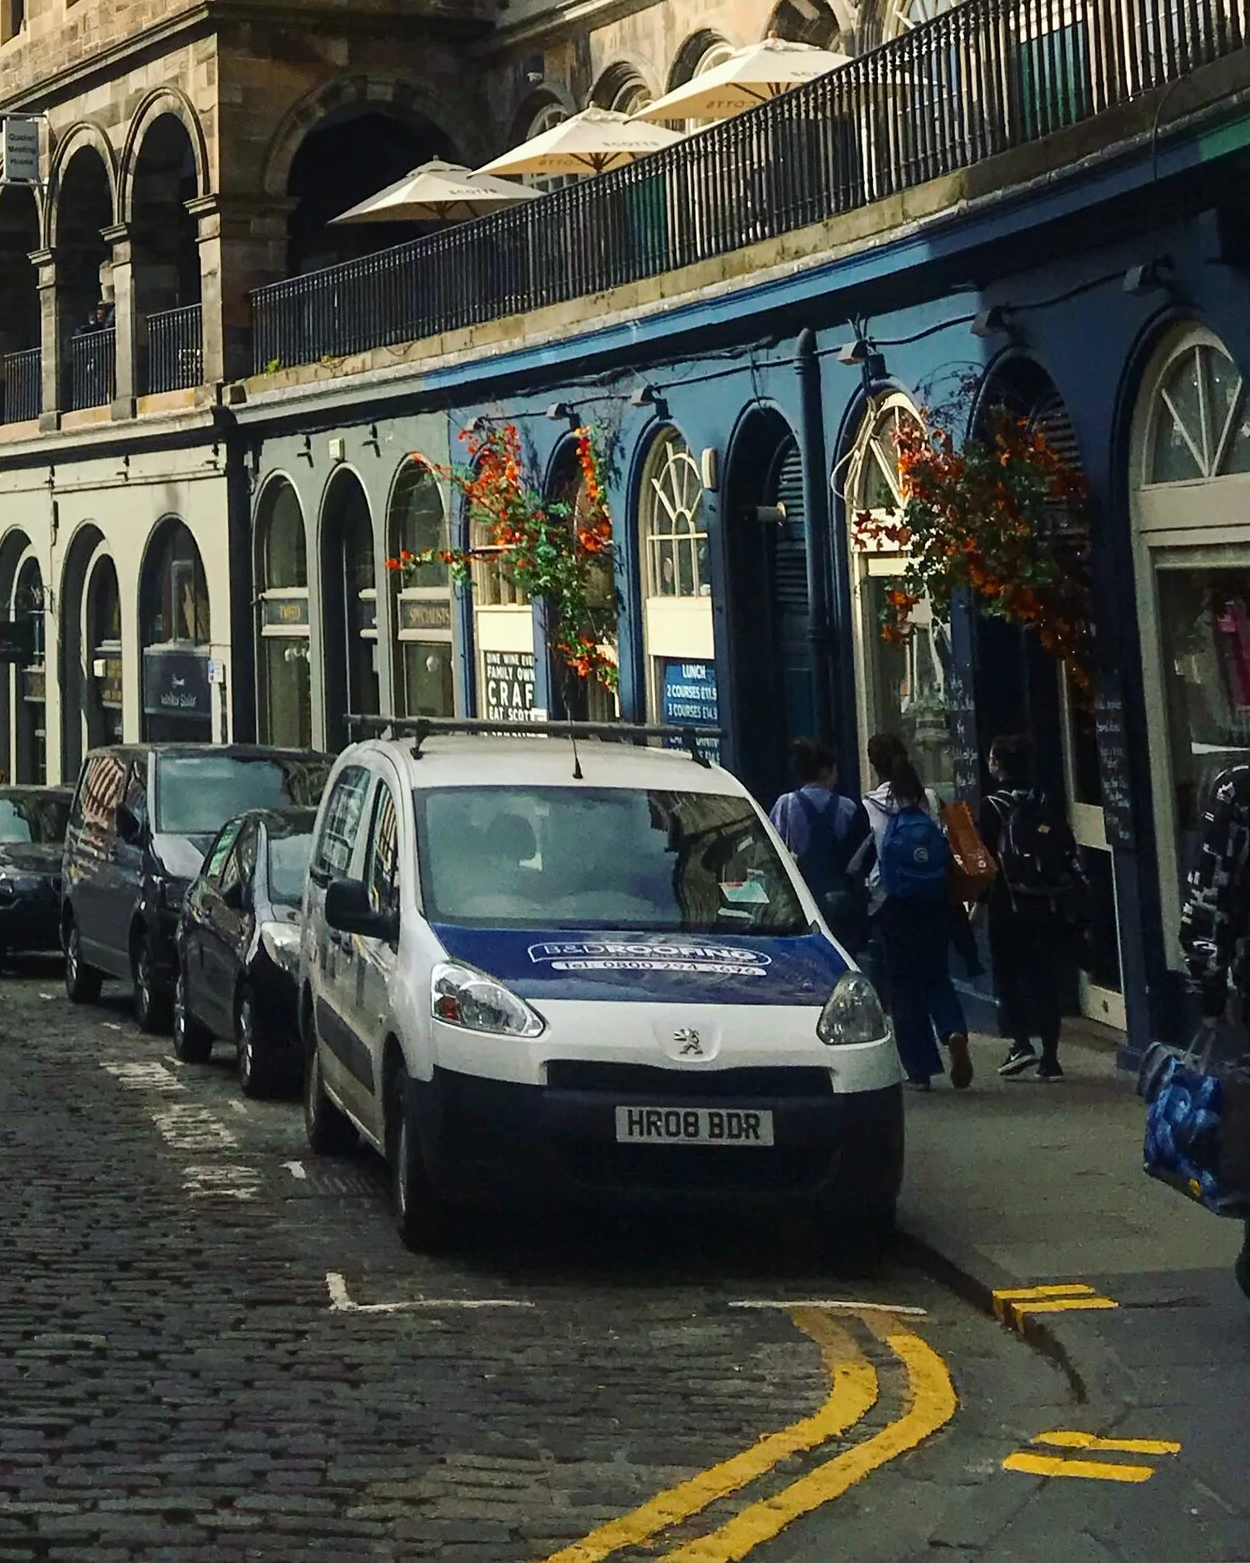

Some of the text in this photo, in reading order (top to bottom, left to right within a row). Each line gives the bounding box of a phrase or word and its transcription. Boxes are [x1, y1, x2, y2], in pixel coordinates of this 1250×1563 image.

[487, 665, 513, 680] FAMILY
[682, 664, 707, 679] LUNCH
[488, 680, 534, 709] CRAF
[667, 684, 671, 697] 2
[672, 685, 700, 699] COURSES
[489, 706, 504, 720] EAT
[668, 704, 672, 716] 3
[673, 703, 701, 718] COURSES
[602, 962, 653, 970] 0800
[627, 1109, 761, 1140] HR08 BDR
